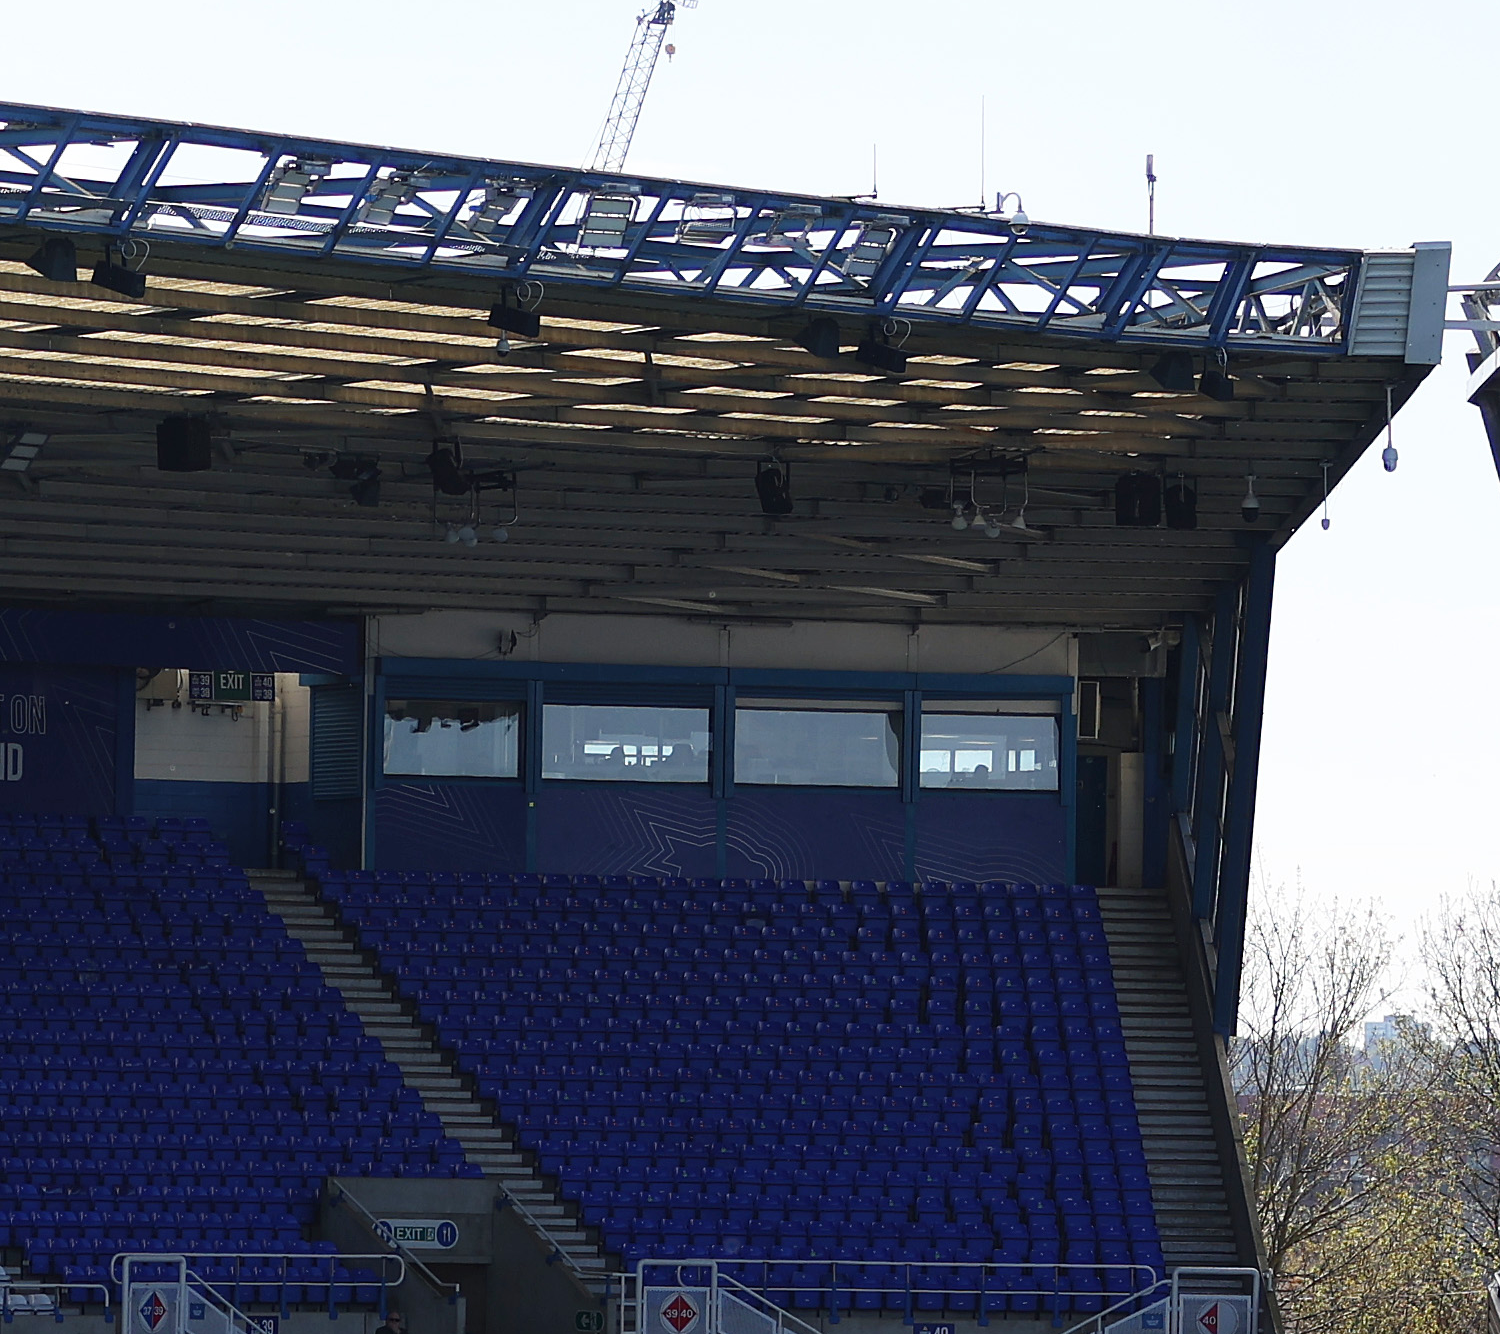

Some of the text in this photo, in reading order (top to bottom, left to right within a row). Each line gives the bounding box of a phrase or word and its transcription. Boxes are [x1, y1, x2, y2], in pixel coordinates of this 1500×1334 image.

[220, 674, 244, 689] EXIT
[11, 694, 46, 735] ON
[397, 1228, 423, 1240] EXIT
[143, 1306, 163, 1315] 37 39
[666, 1309, 692, 1319] 39 40
[1202, 1316, 1216, 1325] 40
